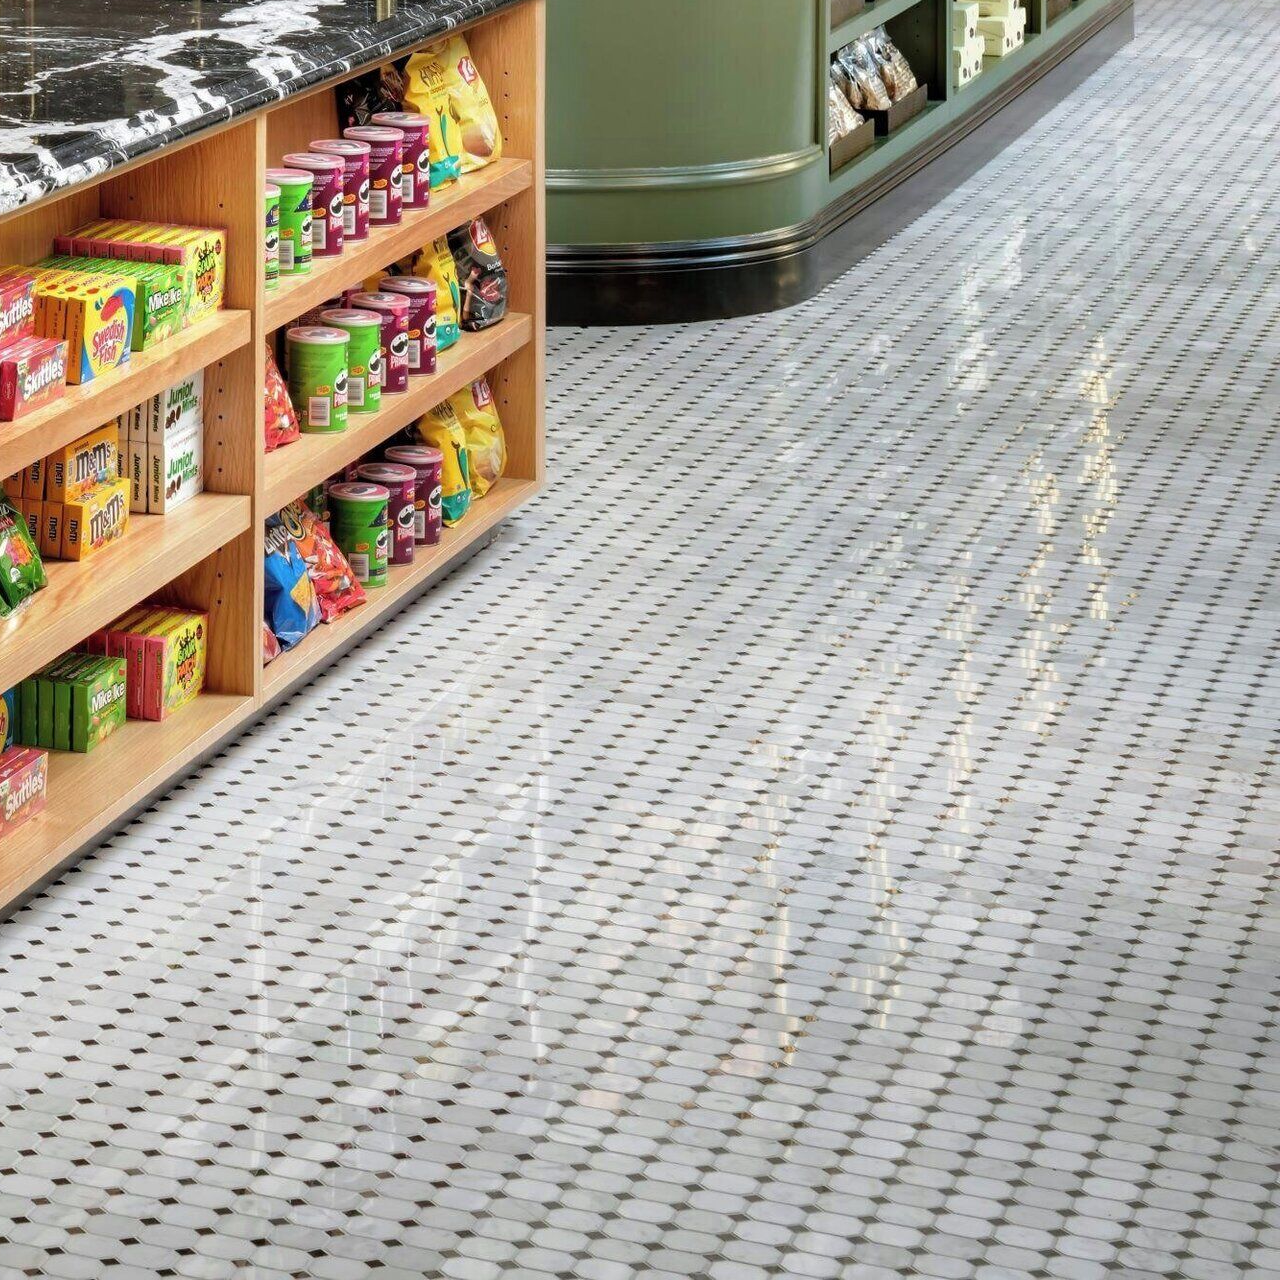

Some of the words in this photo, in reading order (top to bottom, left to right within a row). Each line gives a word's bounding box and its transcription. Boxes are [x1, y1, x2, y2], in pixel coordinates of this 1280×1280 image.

[148, 288, 169, 313] Mike
[171, 288, 182, 304] Ike
[92, 320, 125, 357] Swedish
[98, 342, 117, 366] Fish
[24, 361, 63, 400] Skittles
[167, 381, 194, 407] Junior
[167, 450, 194, 477] Junior
[91, 689, 112, 714] Mike
[112, 682, 126, 699] Ike
[6, 770, 44, 821] Skittles
